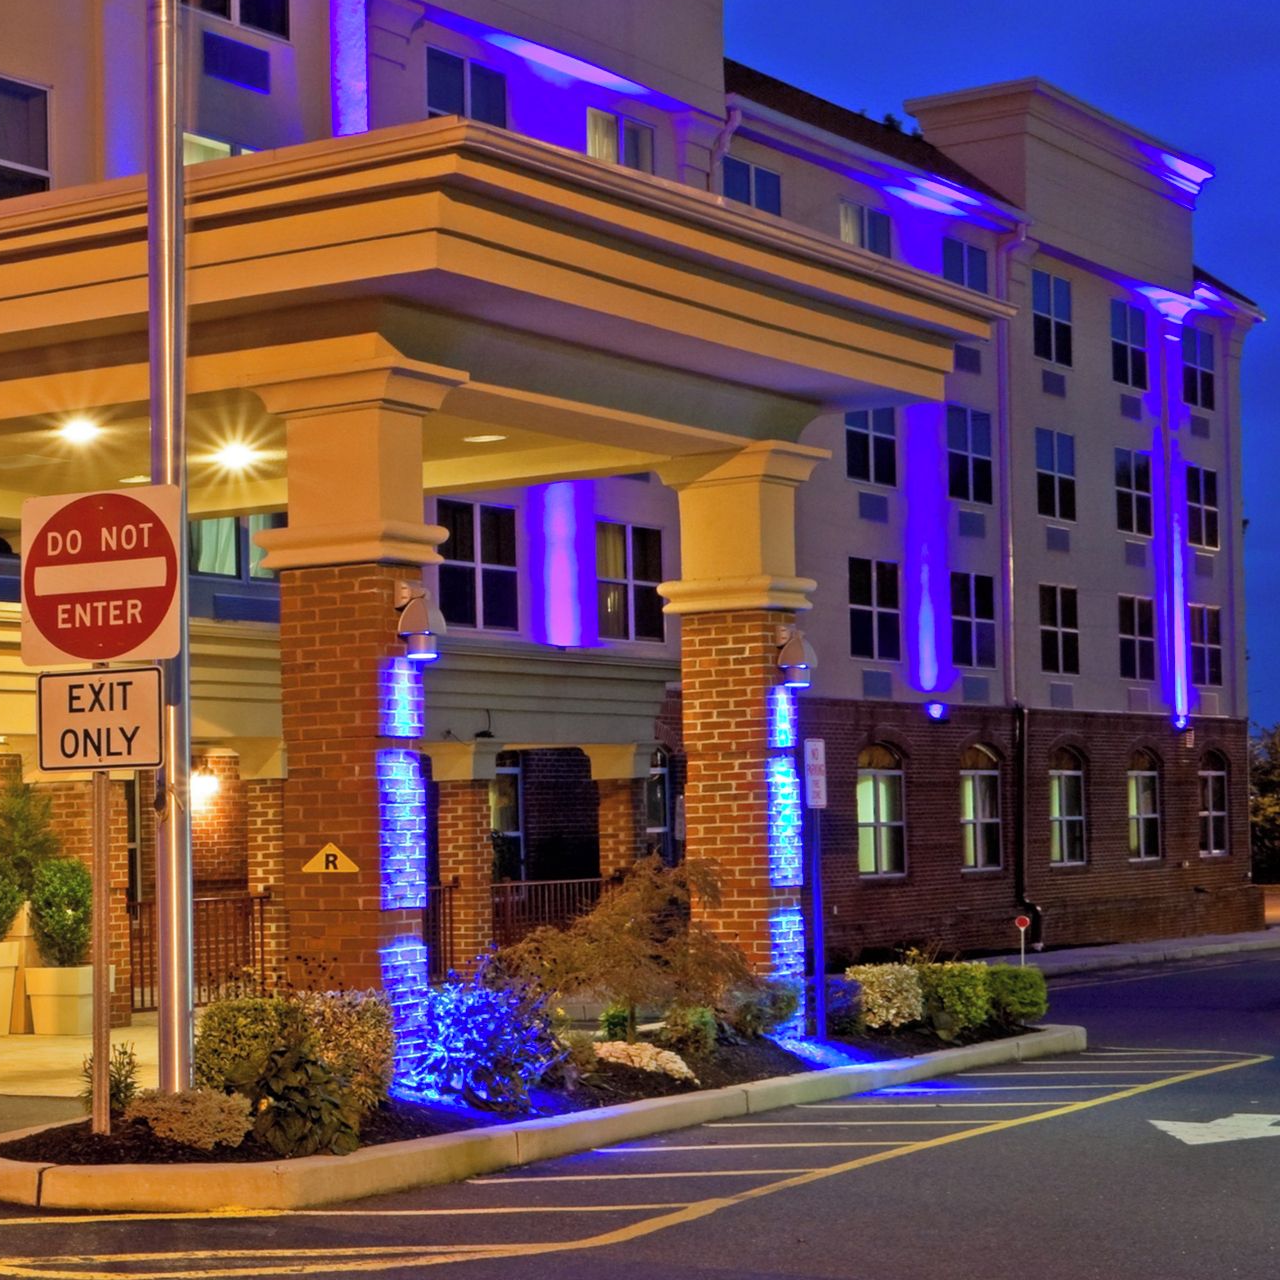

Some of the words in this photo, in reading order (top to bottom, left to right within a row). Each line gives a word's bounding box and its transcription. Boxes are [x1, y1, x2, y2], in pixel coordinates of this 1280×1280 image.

[47, 530, 82, 556] DO
[101, 523, 153, 552] NOT
[57, 599, 143, 629] ENTER
[68, 681, 133, 713] EXIT
[60, 725, 140, 758] ONLY
[324, 853, 339, 870] R
